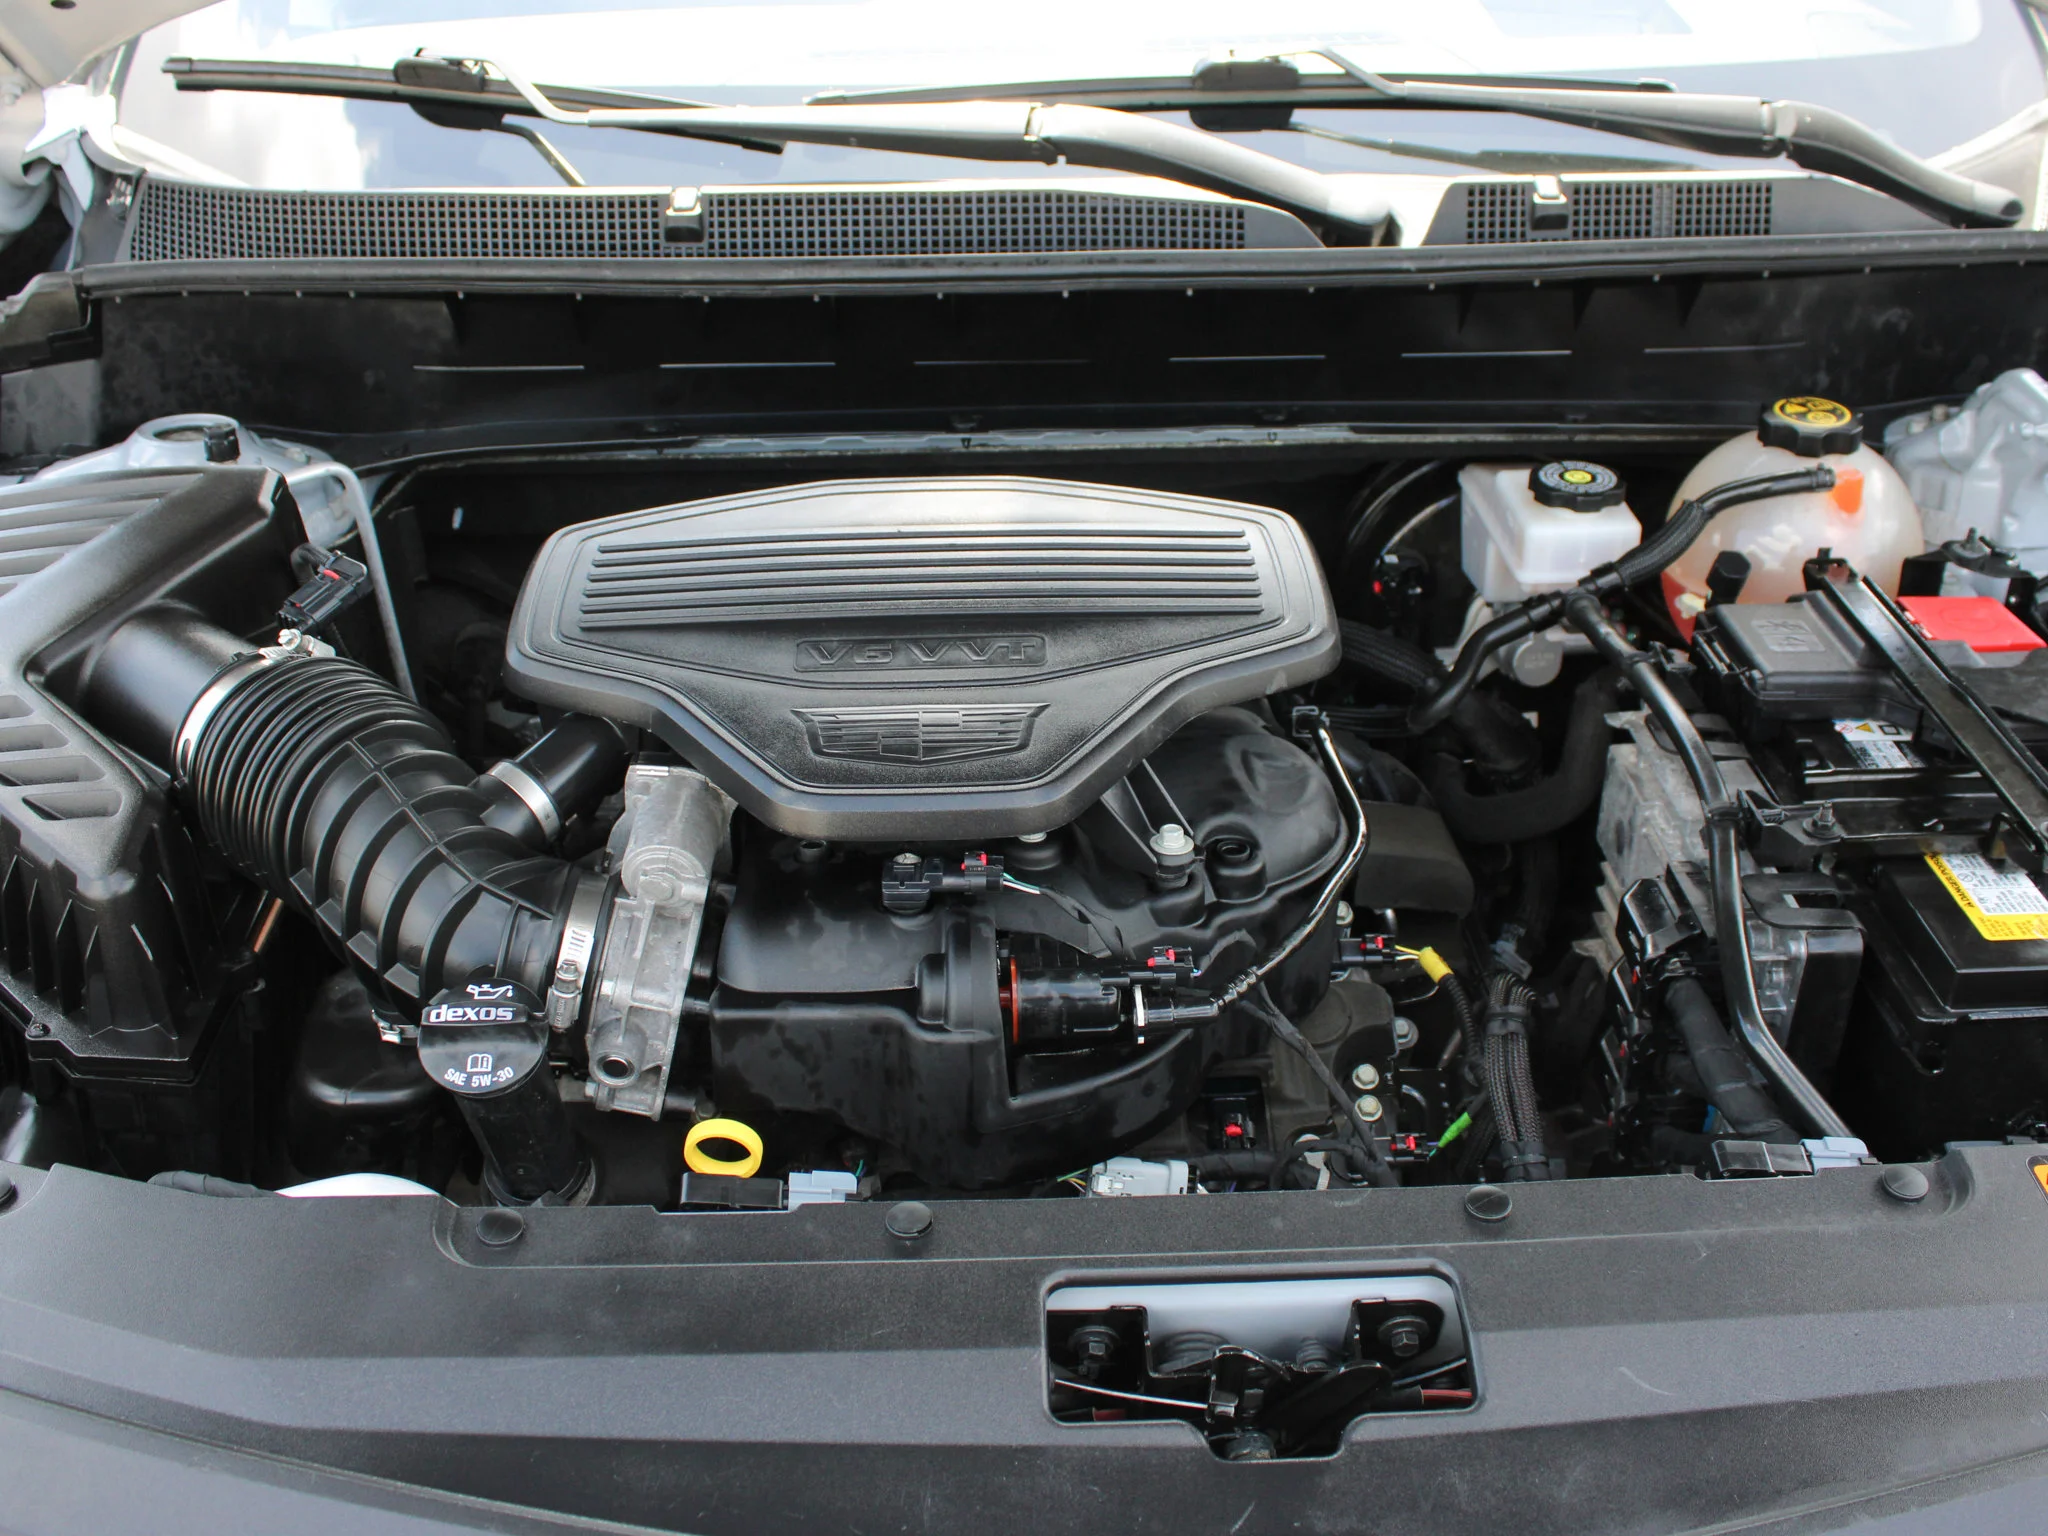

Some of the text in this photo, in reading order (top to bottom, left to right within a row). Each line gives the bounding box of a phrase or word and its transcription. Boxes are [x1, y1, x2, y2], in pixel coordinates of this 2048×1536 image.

[805, 641, 1037, 665] V6 VVT
[429, 1004, 513, 1022] dexos
[444, 1066, 514, 1087] SAE 5W-30
